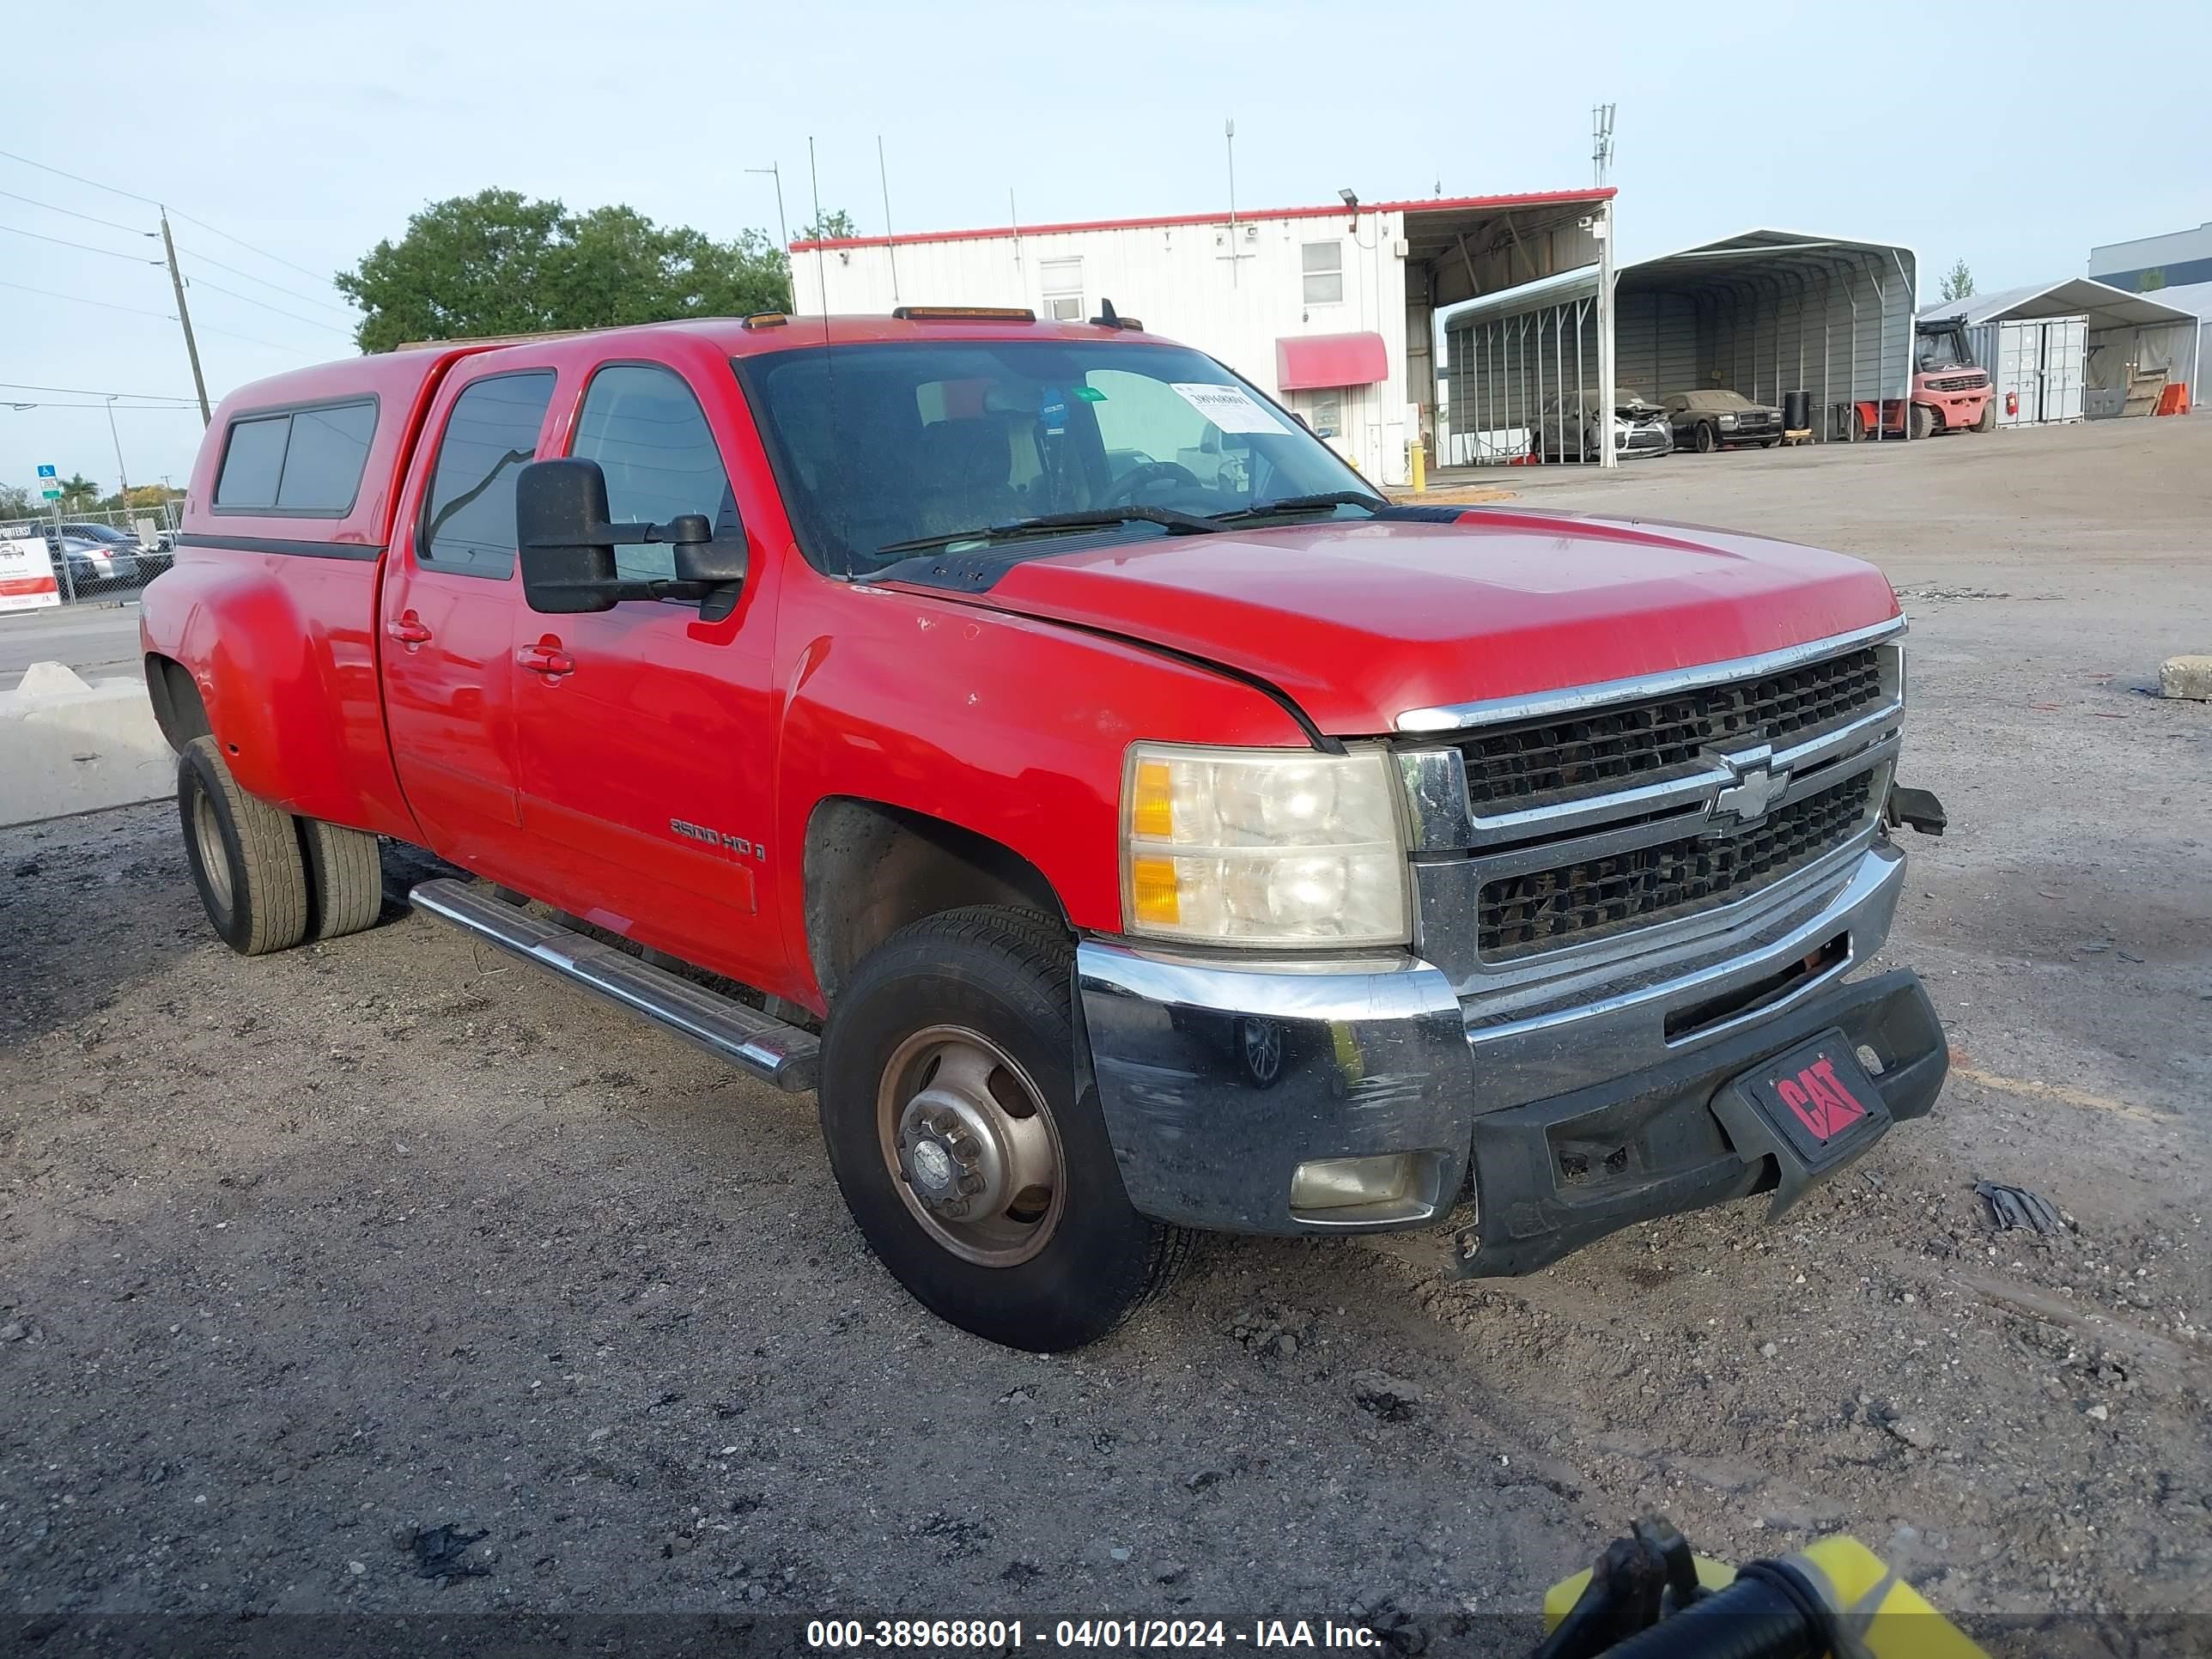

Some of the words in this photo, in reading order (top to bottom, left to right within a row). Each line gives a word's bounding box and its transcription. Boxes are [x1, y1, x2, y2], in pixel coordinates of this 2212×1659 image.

[1188, 394, 1249, 405] 38968801
[670, 817, 718, 845] 3500
[721, 833, 751, 855] HD
[1778, 1059, 1867, 1139] CAT
